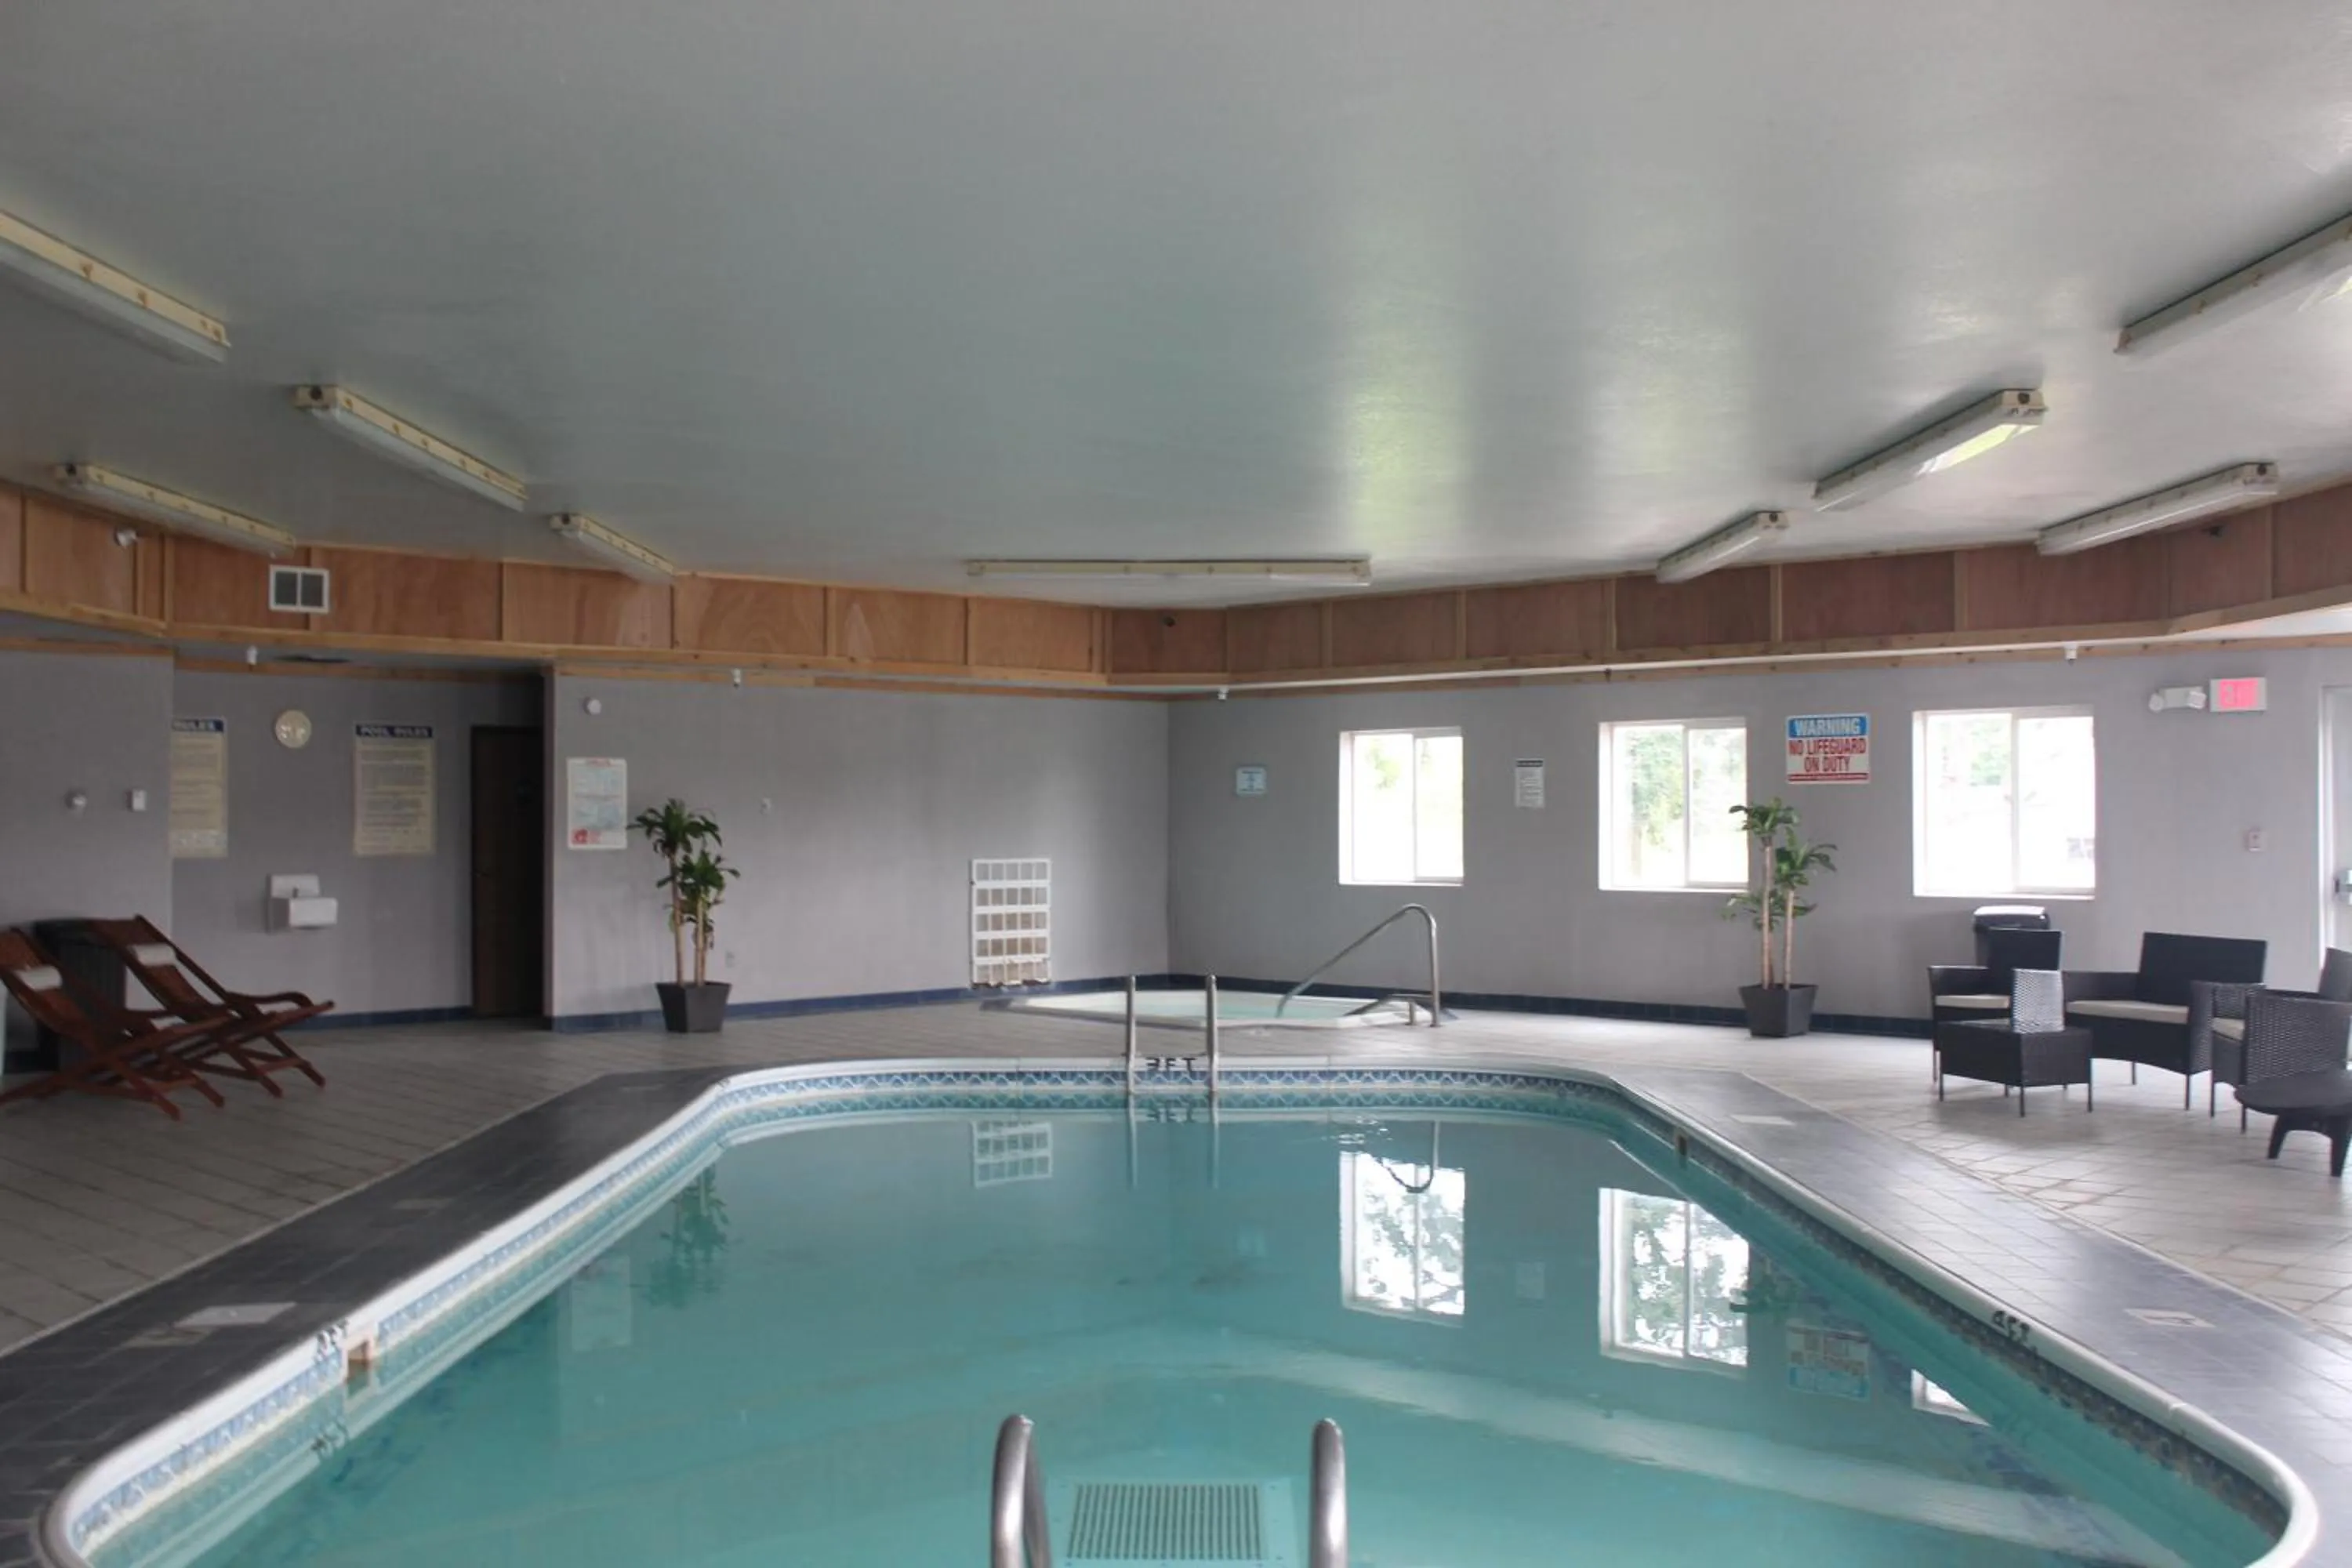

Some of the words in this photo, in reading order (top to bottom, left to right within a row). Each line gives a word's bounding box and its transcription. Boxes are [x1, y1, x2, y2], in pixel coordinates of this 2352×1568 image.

[360, 726, 390, 736] POOL
[394, 727, 429, 736] RULES
[1795, 717, 1861, 735] WARNING
[1788, 740, 1803, 755] NO
[1806, 738, 1866, 754] LIFEGUARD
[1804, 756, 1819, 772] ON
[1823, 756, 1850, 772] DUTY
